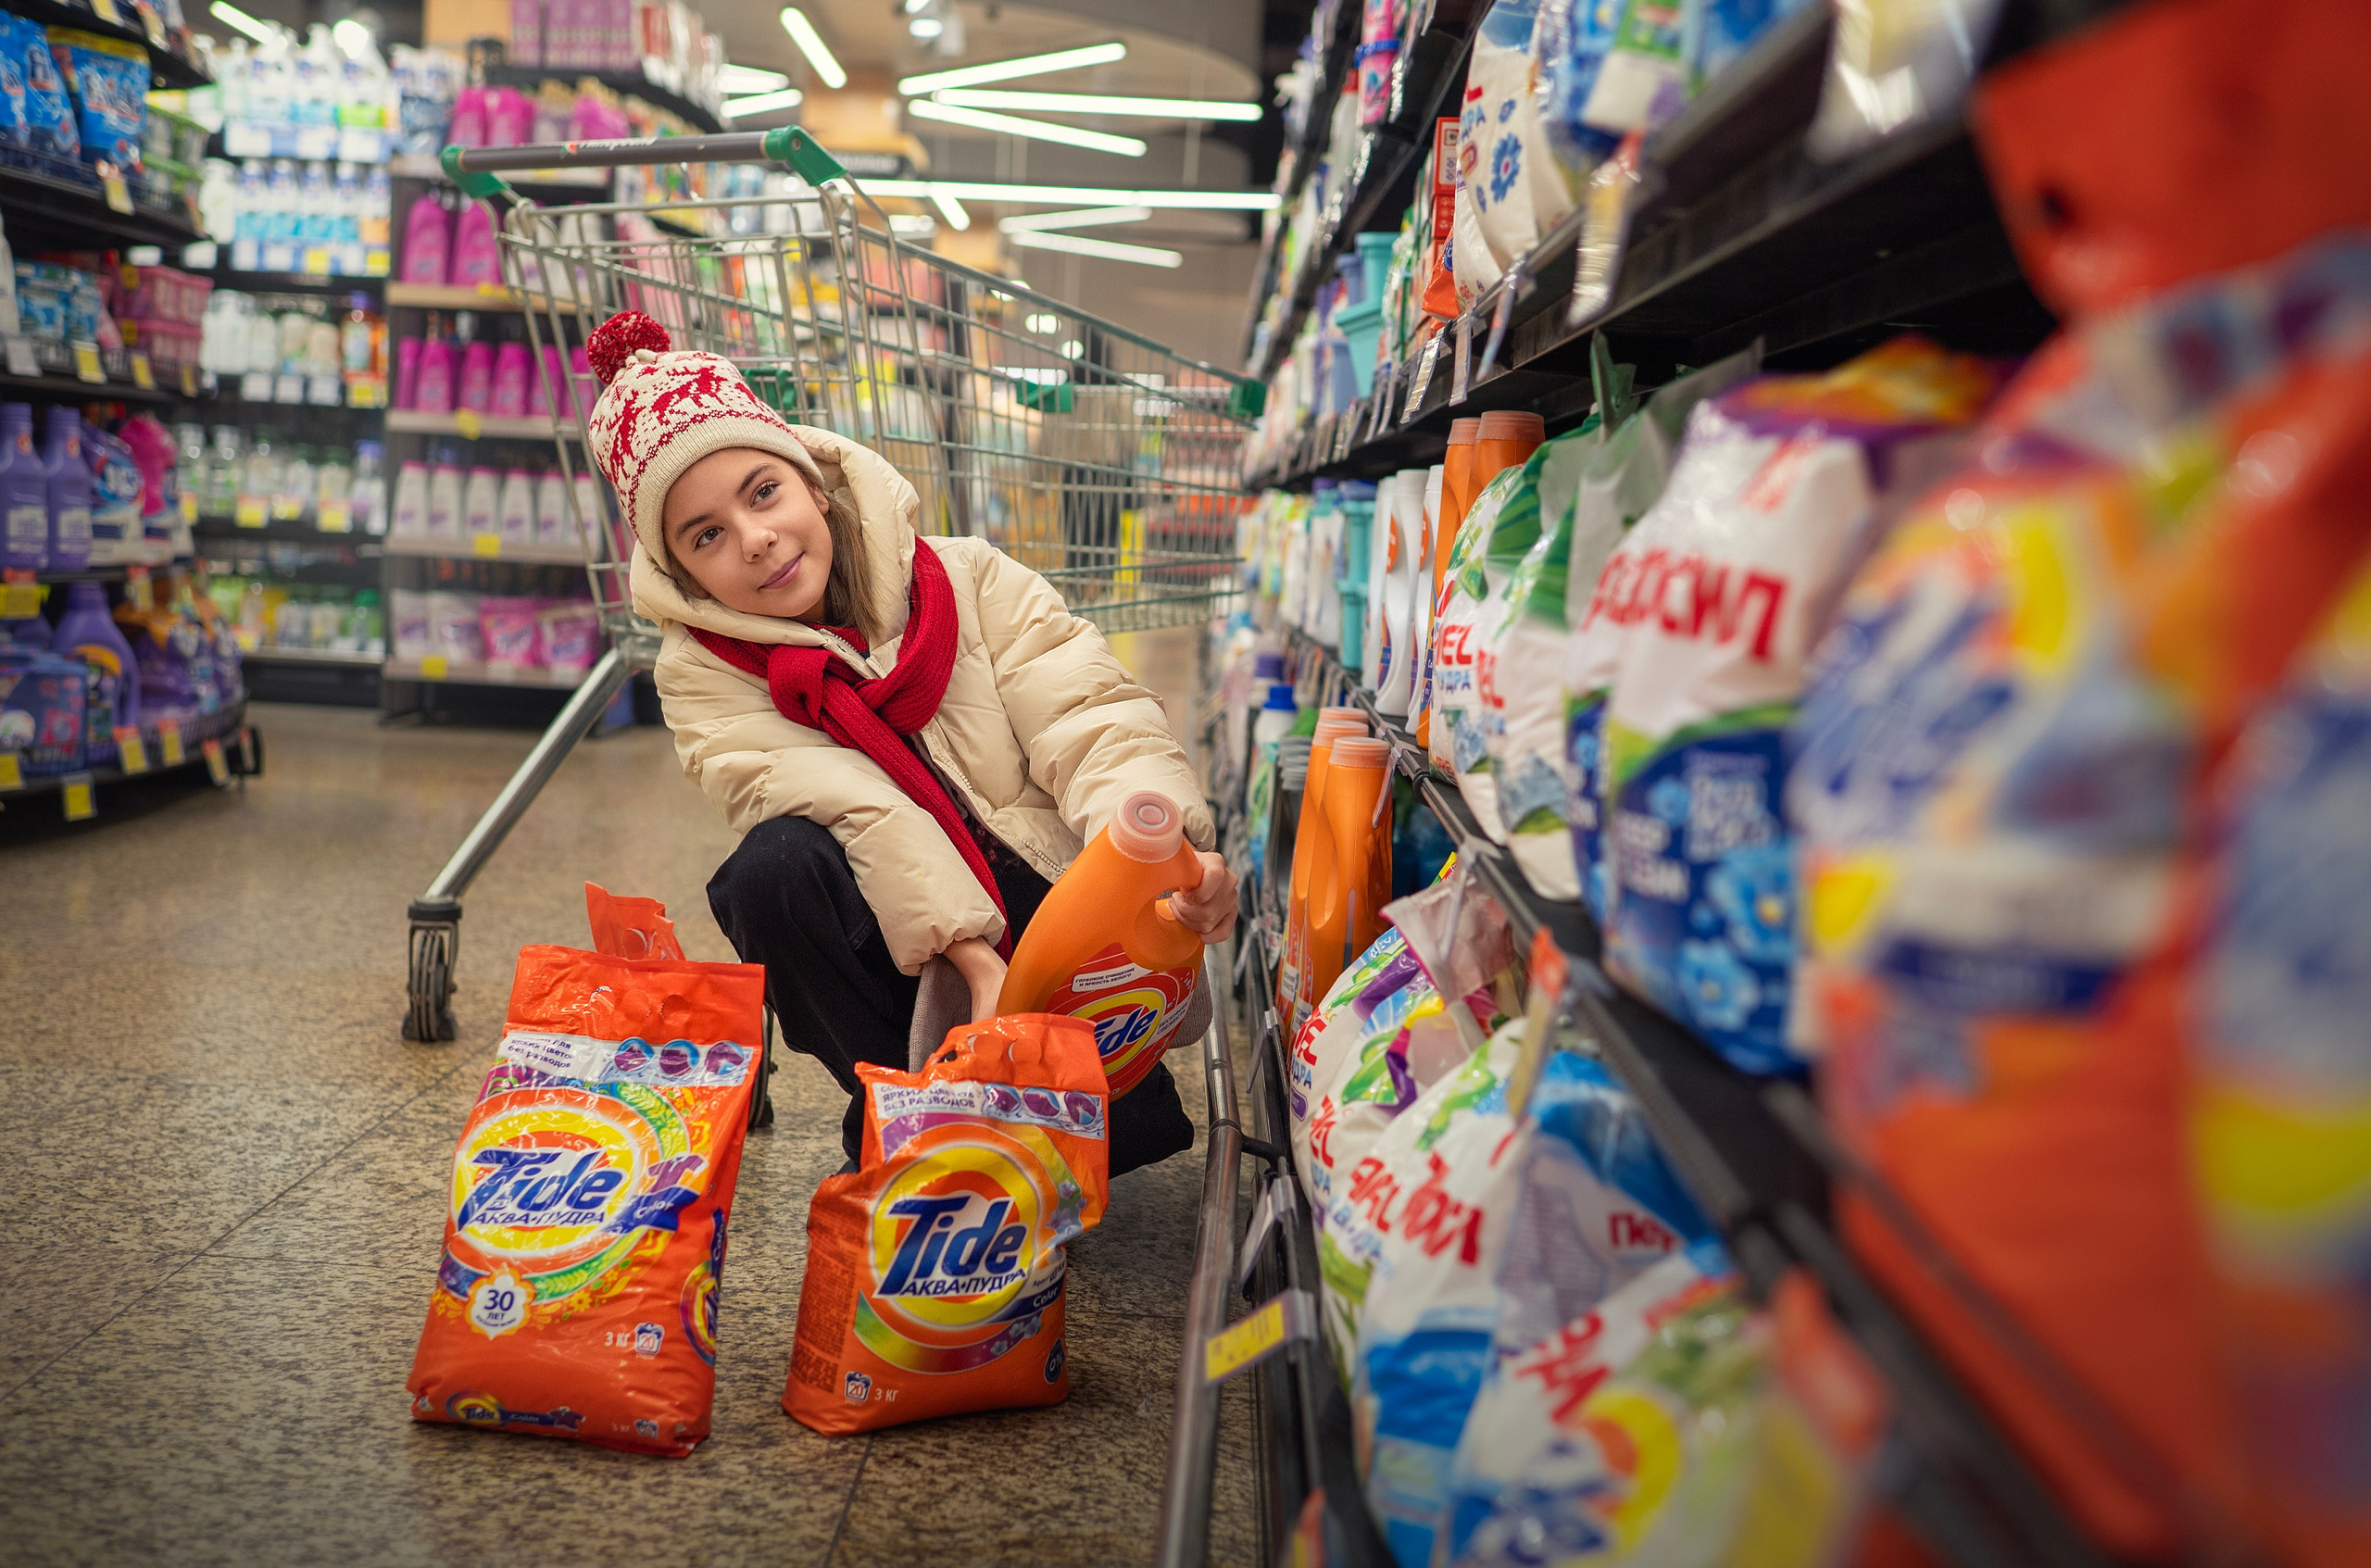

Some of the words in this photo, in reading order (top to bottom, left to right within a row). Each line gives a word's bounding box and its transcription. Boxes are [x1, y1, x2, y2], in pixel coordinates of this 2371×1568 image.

[458, 1149, 623, 1233] Tide
[877, 1195, 1027, 1296] Tide
[483, 1288, 515, 1312] 30
[1033, 1286, 1060, 1308] Color
[486, 1311, 506, 1321] ЛЕТ
[604, 1331, 613, 1347] 3
[639, 1335, 656, 1349] 20
[849, 1382, 864, 1397] 20
[874, 1387, 883, 1400] 3
